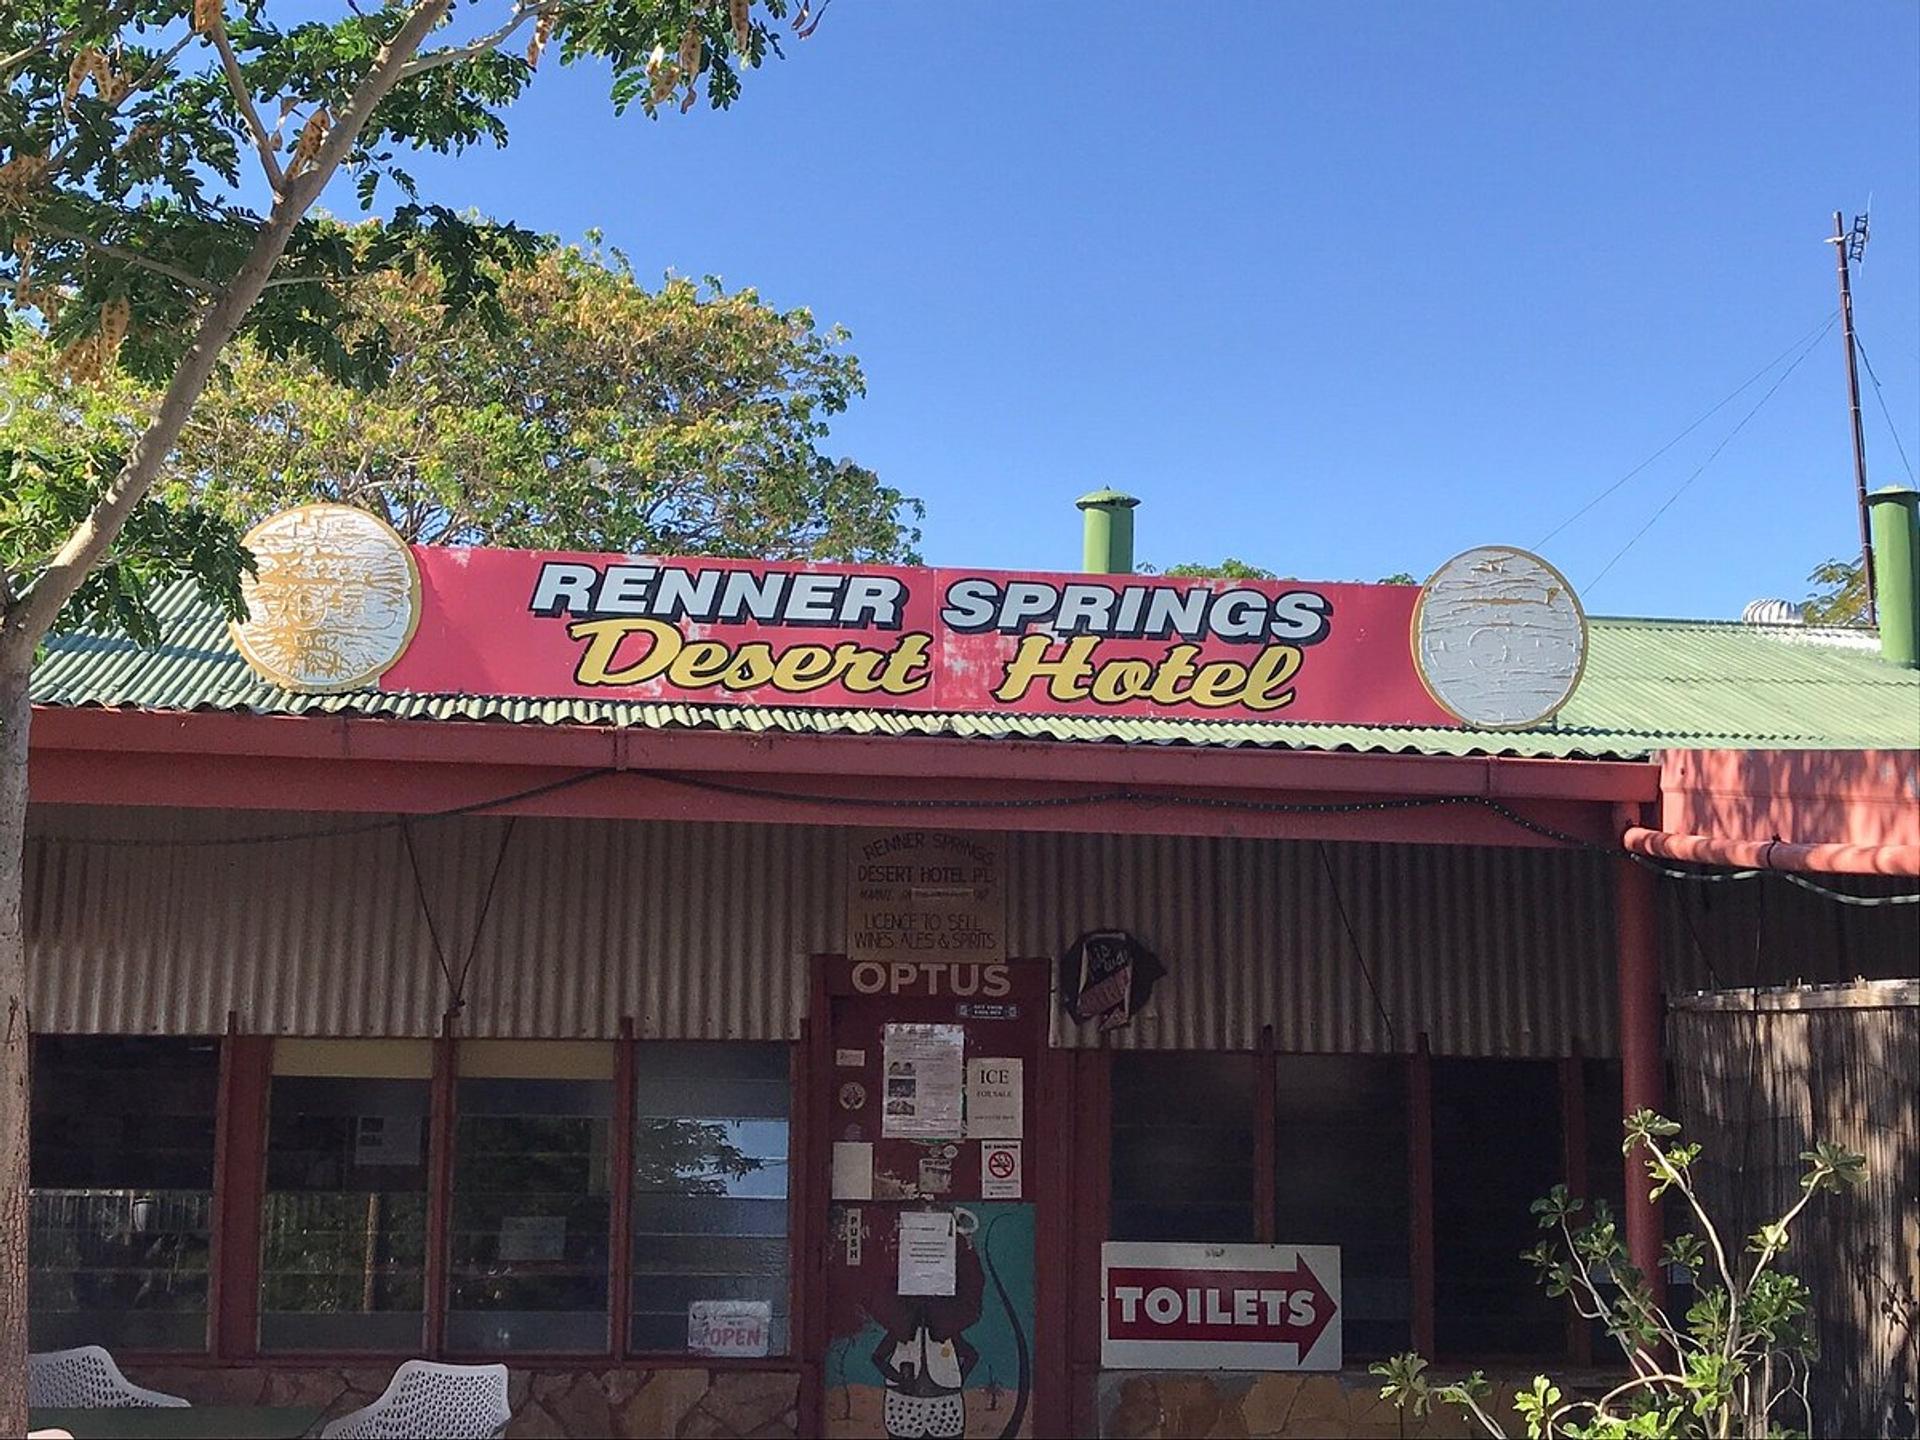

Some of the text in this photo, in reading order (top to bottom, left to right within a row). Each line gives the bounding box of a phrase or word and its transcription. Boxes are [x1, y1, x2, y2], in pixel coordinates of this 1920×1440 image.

[530, 563, 1331, 644] RENNER SPRINGS
[570, 617, 1305, 712] Desert Hotel
[862, 831, 996, 866] RENNER SPRINGS
[857, 865, 914, 882] DESERT
[920, 866, 966, 883] HOTEL
[864, 912, 980, 931] LICENCE TO SELL
[901, 932, 933, 949] ALES
[938, 932, 950, 949] &
[851, 962, 1011, 997] OPTUS
[980, 1069, 1009, 1084] ICE
[849, 1216, 858, 1259] PUSH
[1114, 1286, 1316, 1327] TOILETS
[711, 1327, 760, 1346] OPEN
